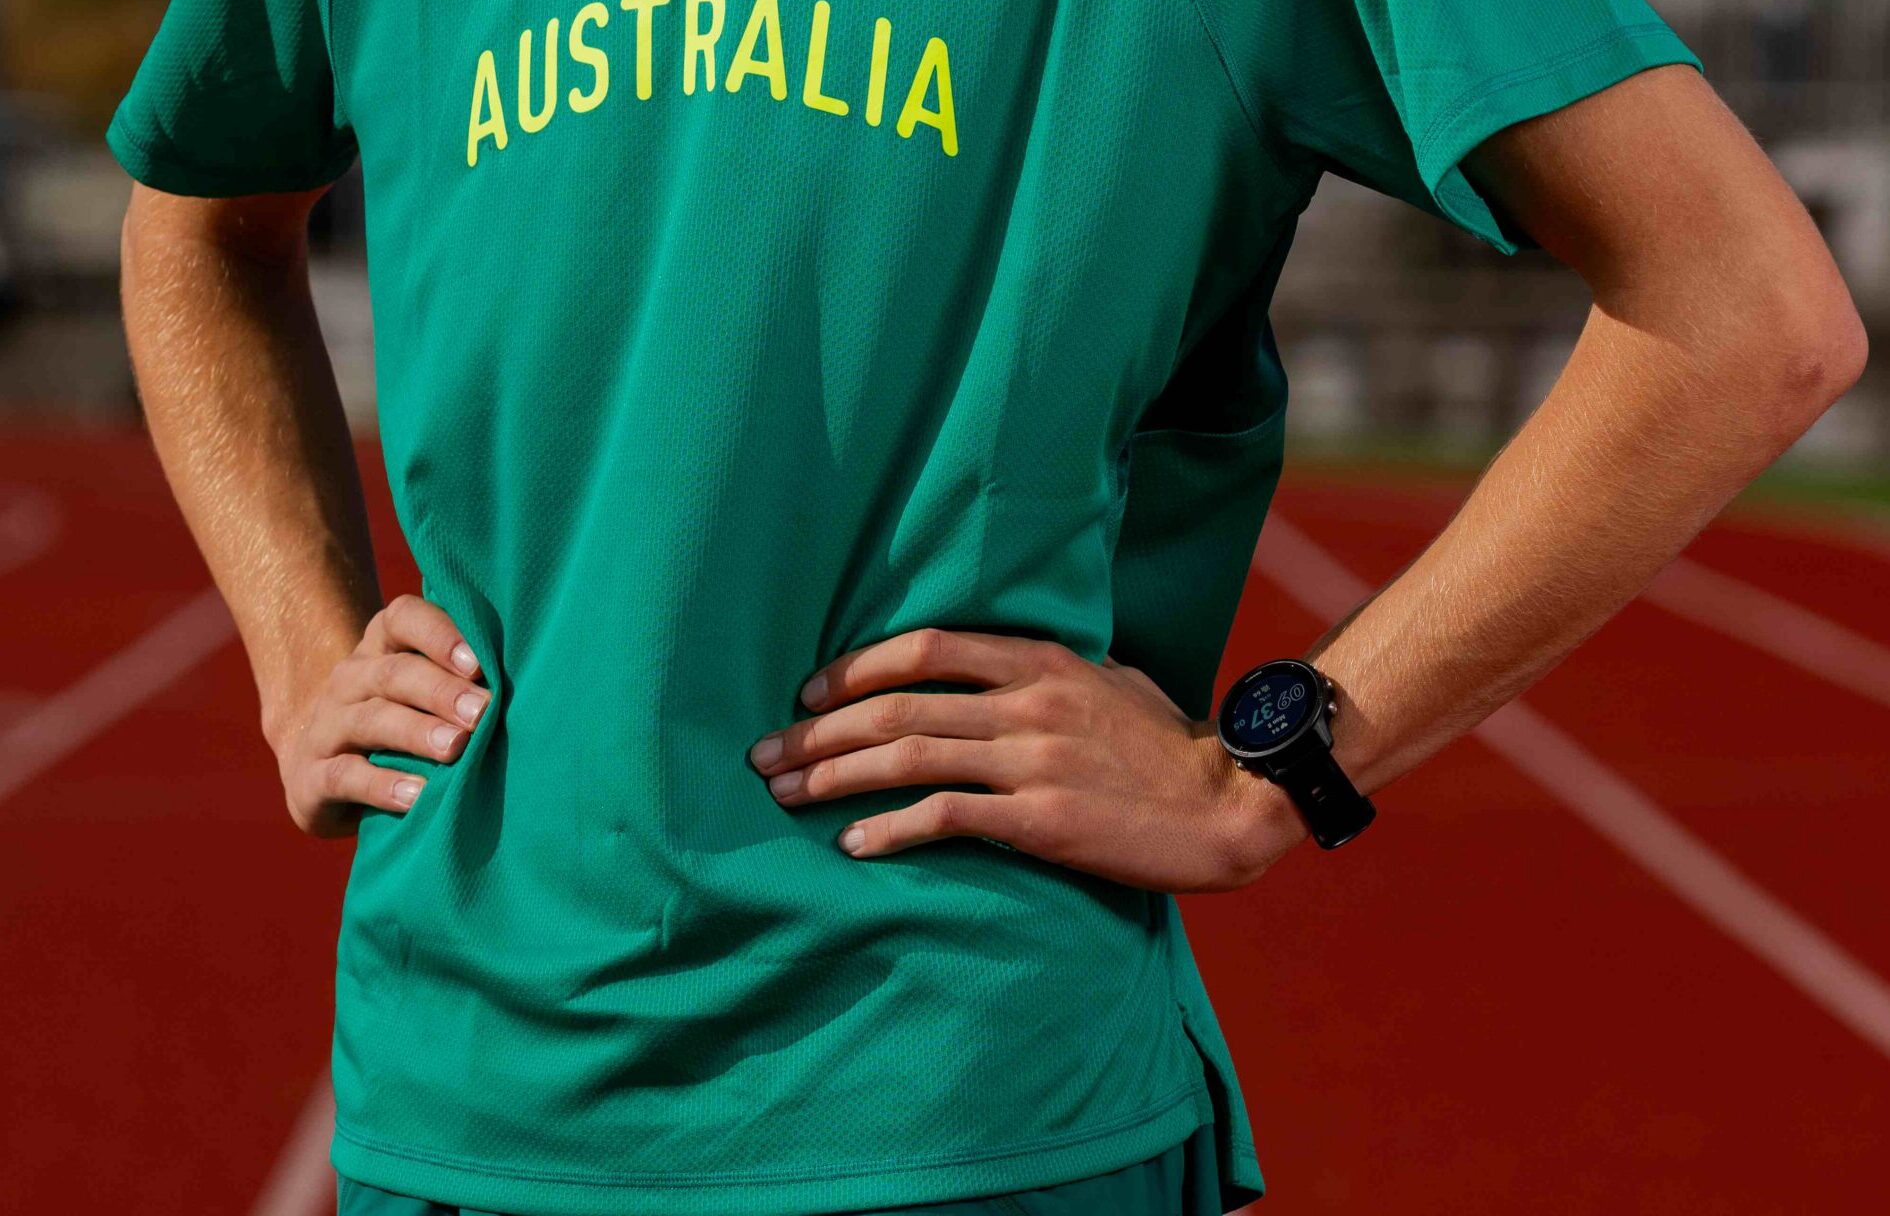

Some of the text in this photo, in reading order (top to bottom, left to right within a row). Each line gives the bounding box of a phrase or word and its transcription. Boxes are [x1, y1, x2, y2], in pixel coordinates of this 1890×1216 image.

[1277, 683, 1305, 710] 09
[1250, 702, 1275, 730] 37
[1272, 714, 1286, 724] Mon
